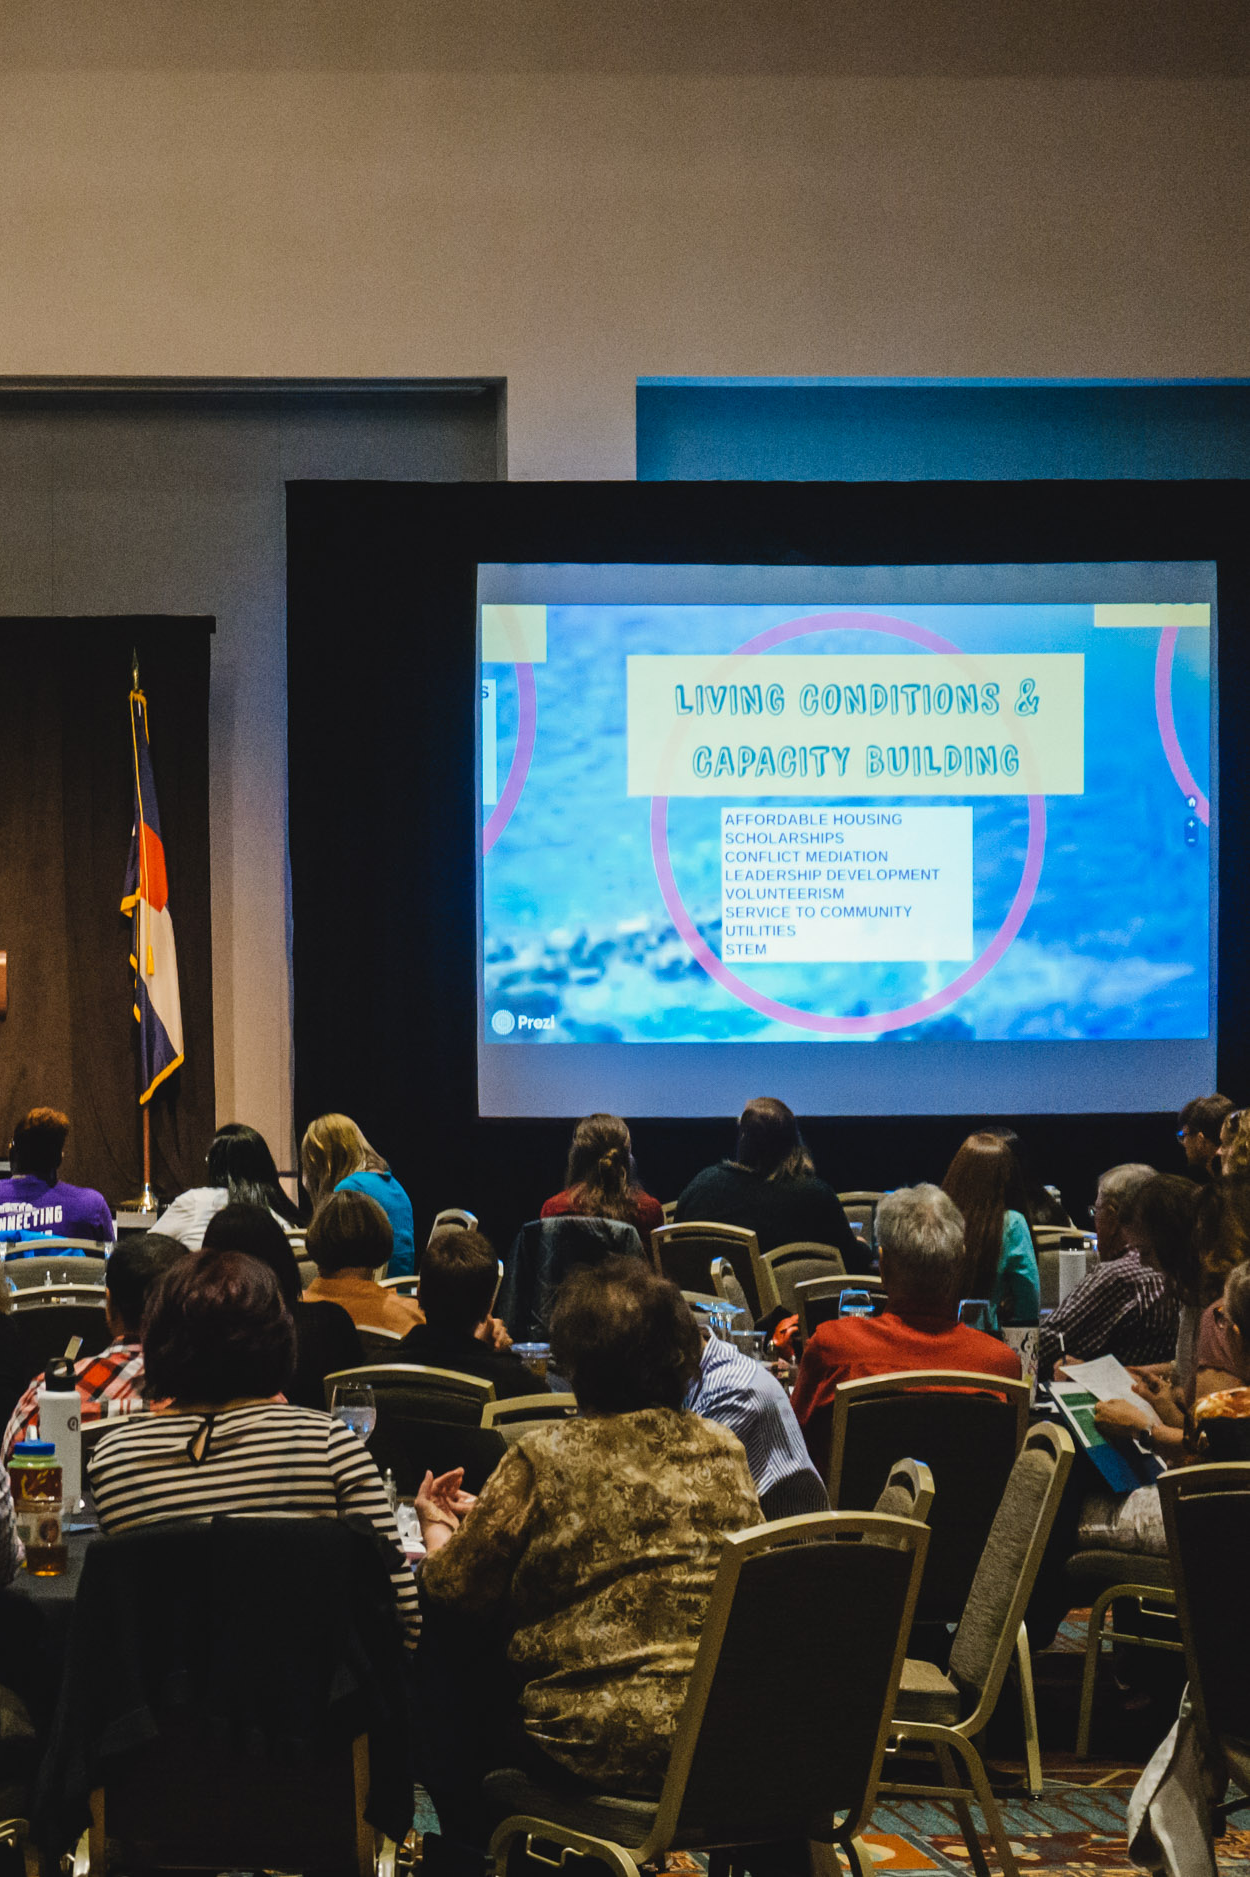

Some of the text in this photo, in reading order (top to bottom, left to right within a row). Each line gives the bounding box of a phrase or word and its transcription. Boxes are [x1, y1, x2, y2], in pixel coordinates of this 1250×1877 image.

[675, 678, 1041, 716] LIVING CONDITIONS &
[692, 744, 1020, 779] CAPACITY BUILDING
[725, 813, 903, 826] AFFORDABLE HOUSING
[725, 832, 845, 845] SCHOLARSHIPS
[725, 850, 889, 863] CONFLICT MEDIATION
[725, 868, 940, 881] LEADERSHIP DEVELOPMENT
[725, 887, 845, 900] VOLUNTEERISM
[725, 905, 913, 919] SERVICE TO COMMUNITY
[725, 925, 797, 937] UTILITIES
[725, 943, 767, 956] STEM
